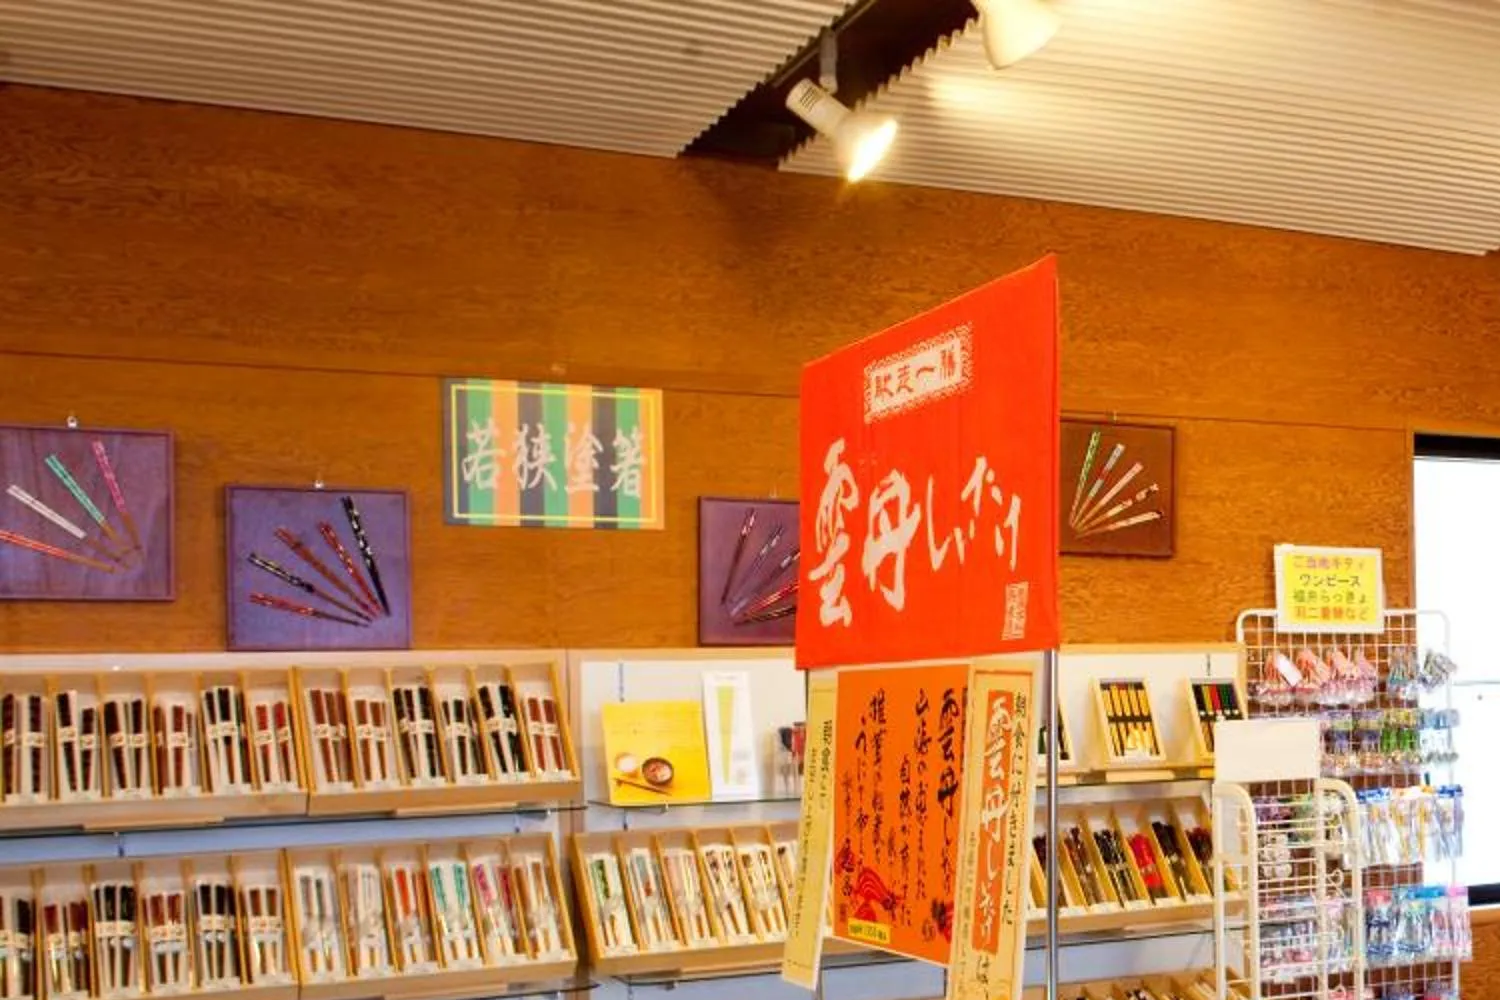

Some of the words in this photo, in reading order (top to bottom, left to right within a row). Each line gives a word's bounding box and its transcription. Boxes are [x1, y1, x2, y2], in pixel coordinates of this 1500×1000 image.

[1299, 574, 1361, 587] ワンピース
